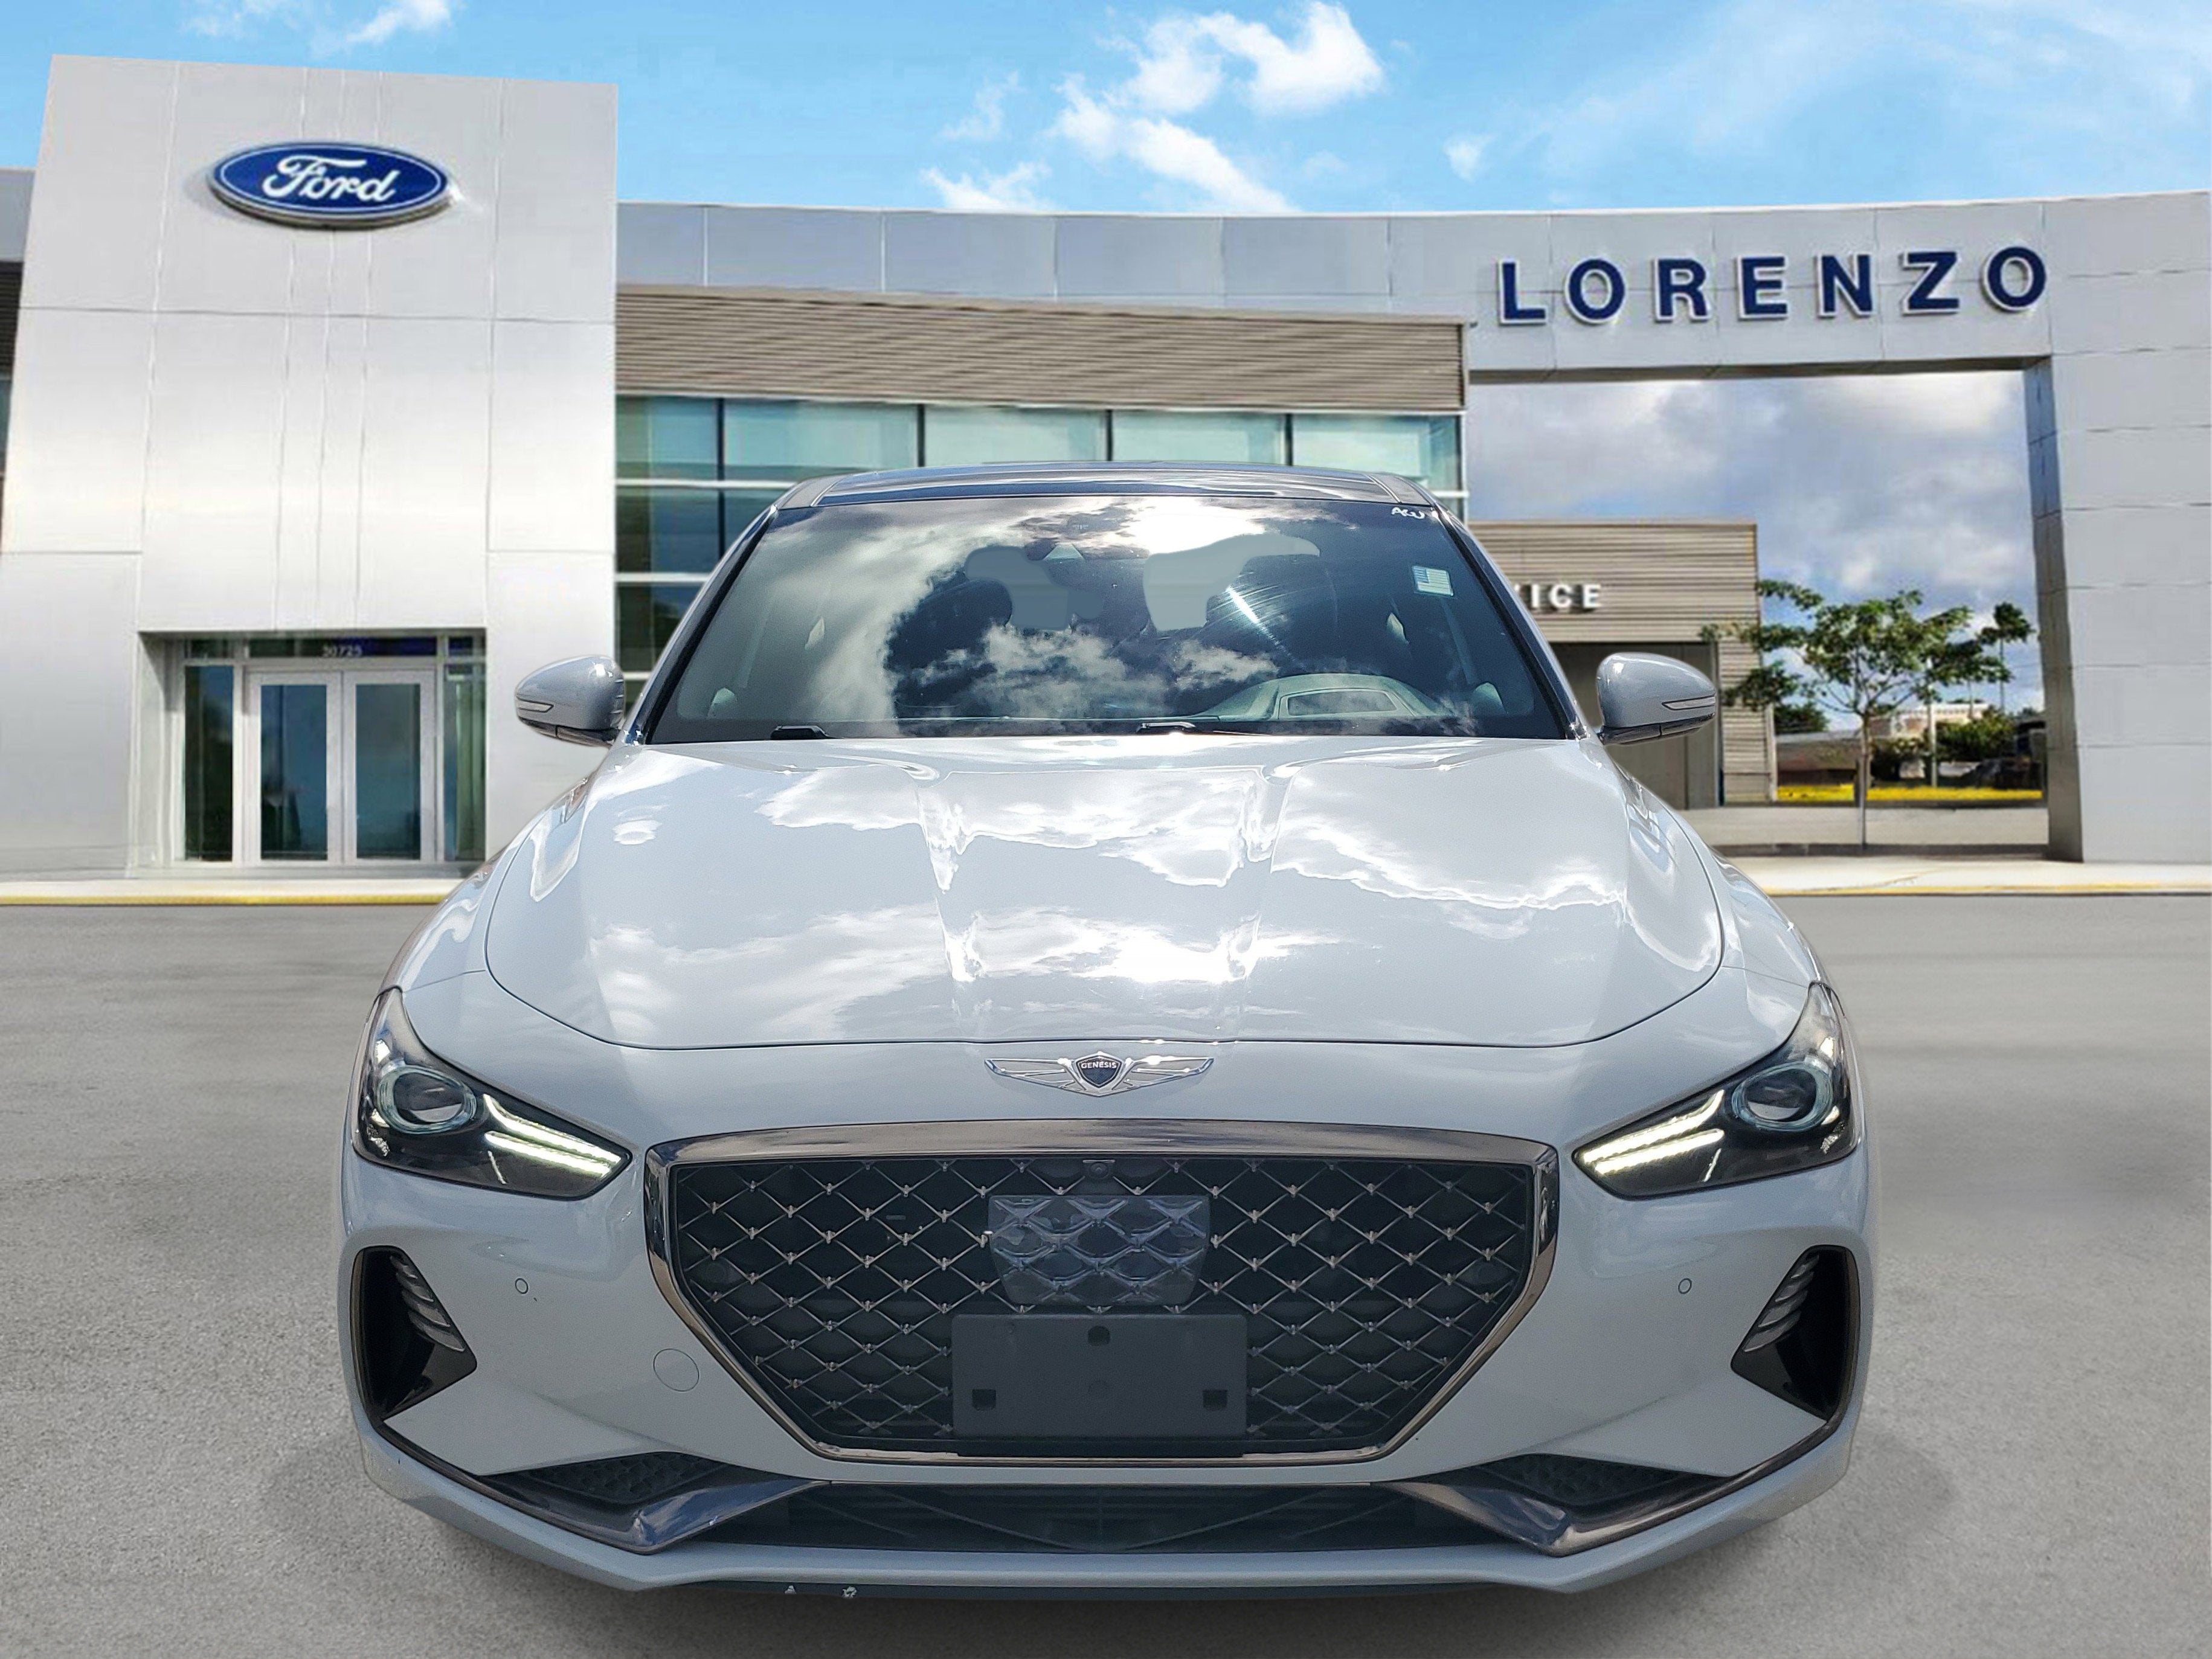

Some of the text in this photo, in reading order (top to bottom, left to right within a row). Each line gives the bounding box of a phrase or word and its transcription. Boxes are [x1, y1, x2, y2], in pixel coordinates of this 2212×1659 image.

[262, 154, 401, 202] Ford
[1497, 245, 2048, 325] LORENZO
[1514, 583, 1603, 609] ICE
